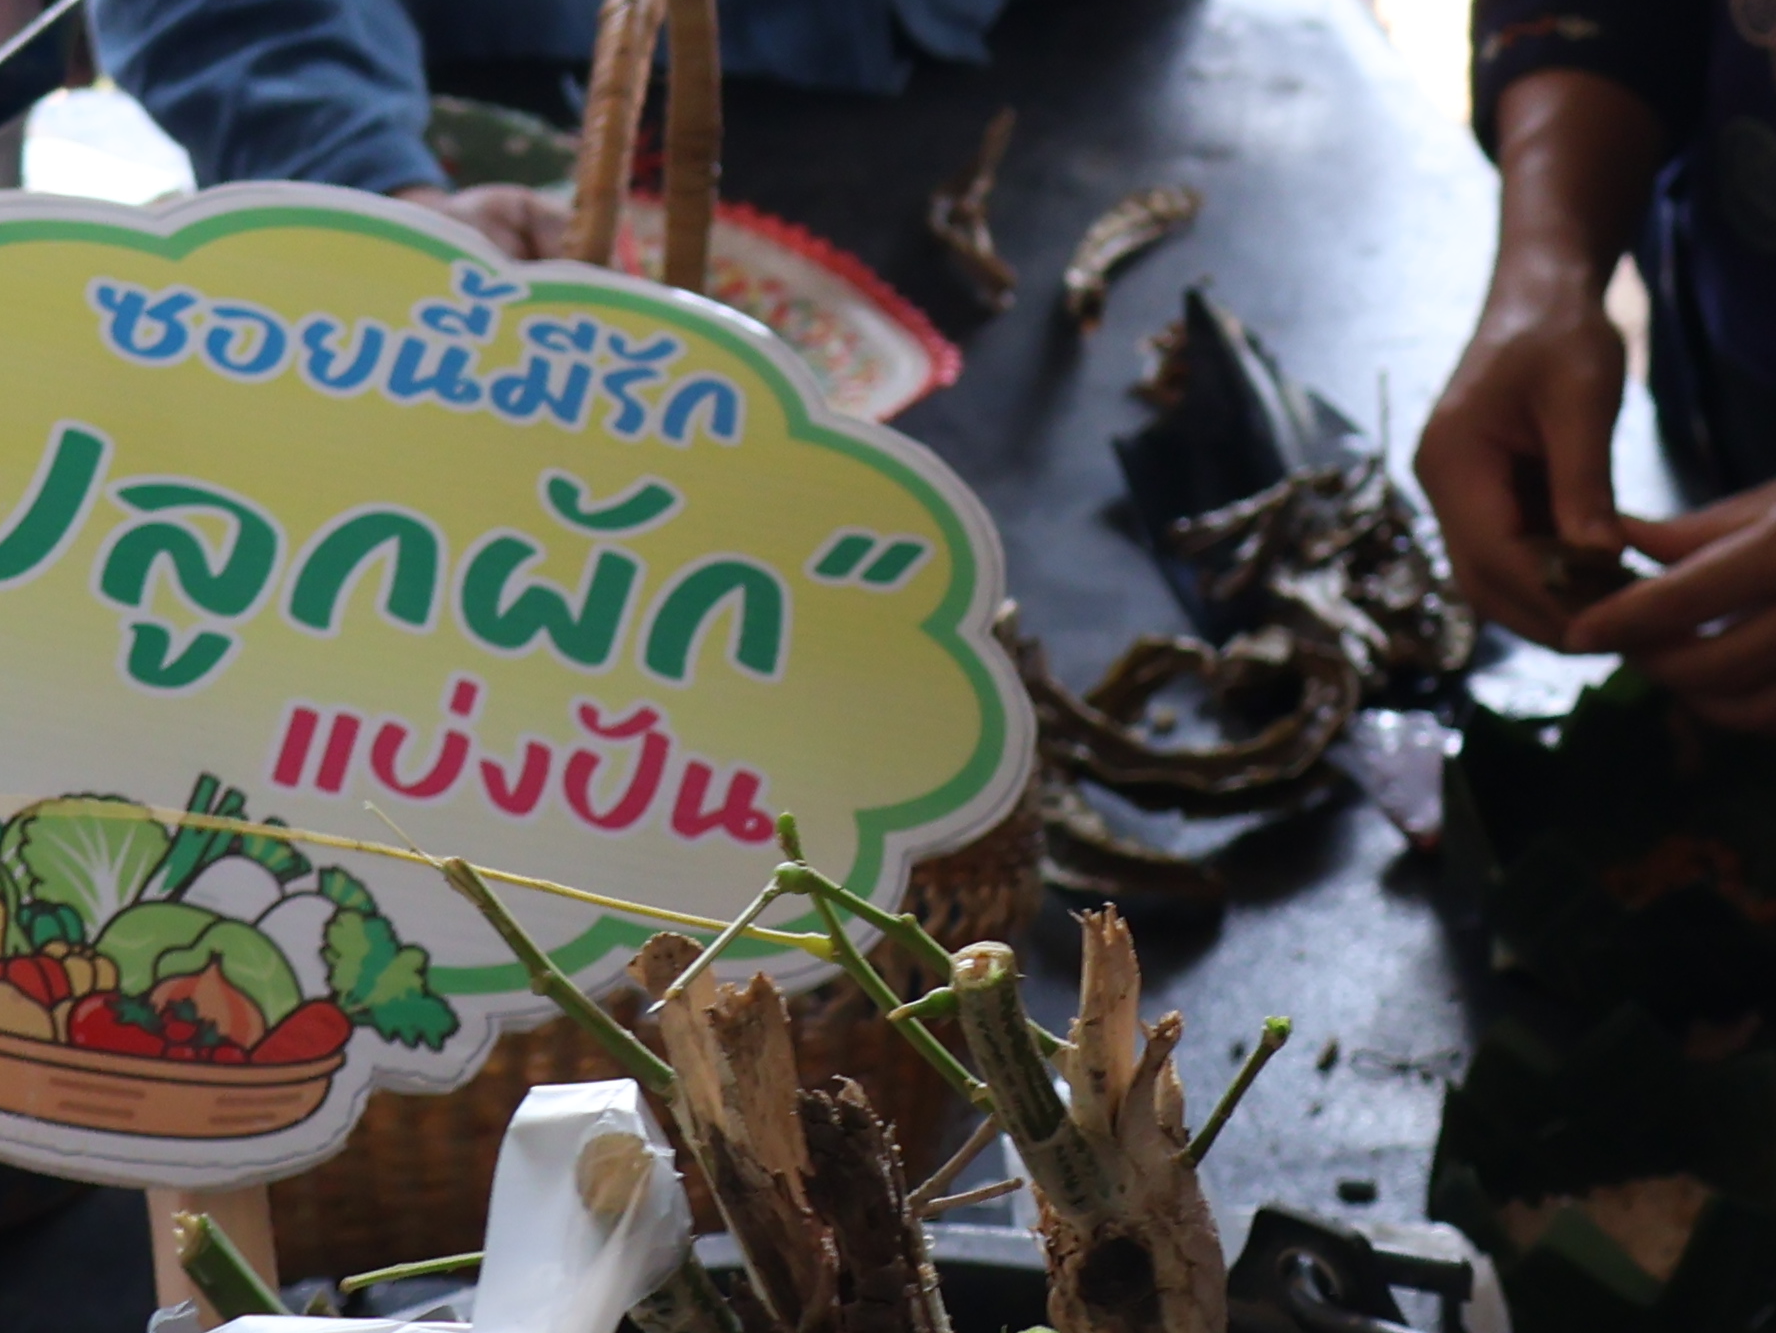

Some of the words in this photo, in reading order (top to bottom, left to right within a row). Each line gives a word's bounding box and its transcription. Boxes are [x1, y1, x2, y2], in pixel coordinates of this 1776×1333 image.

[96, 268, 737, 440] ซอยนี้มีรัก
[271, 679, 777, 845] แบ่งปัน
